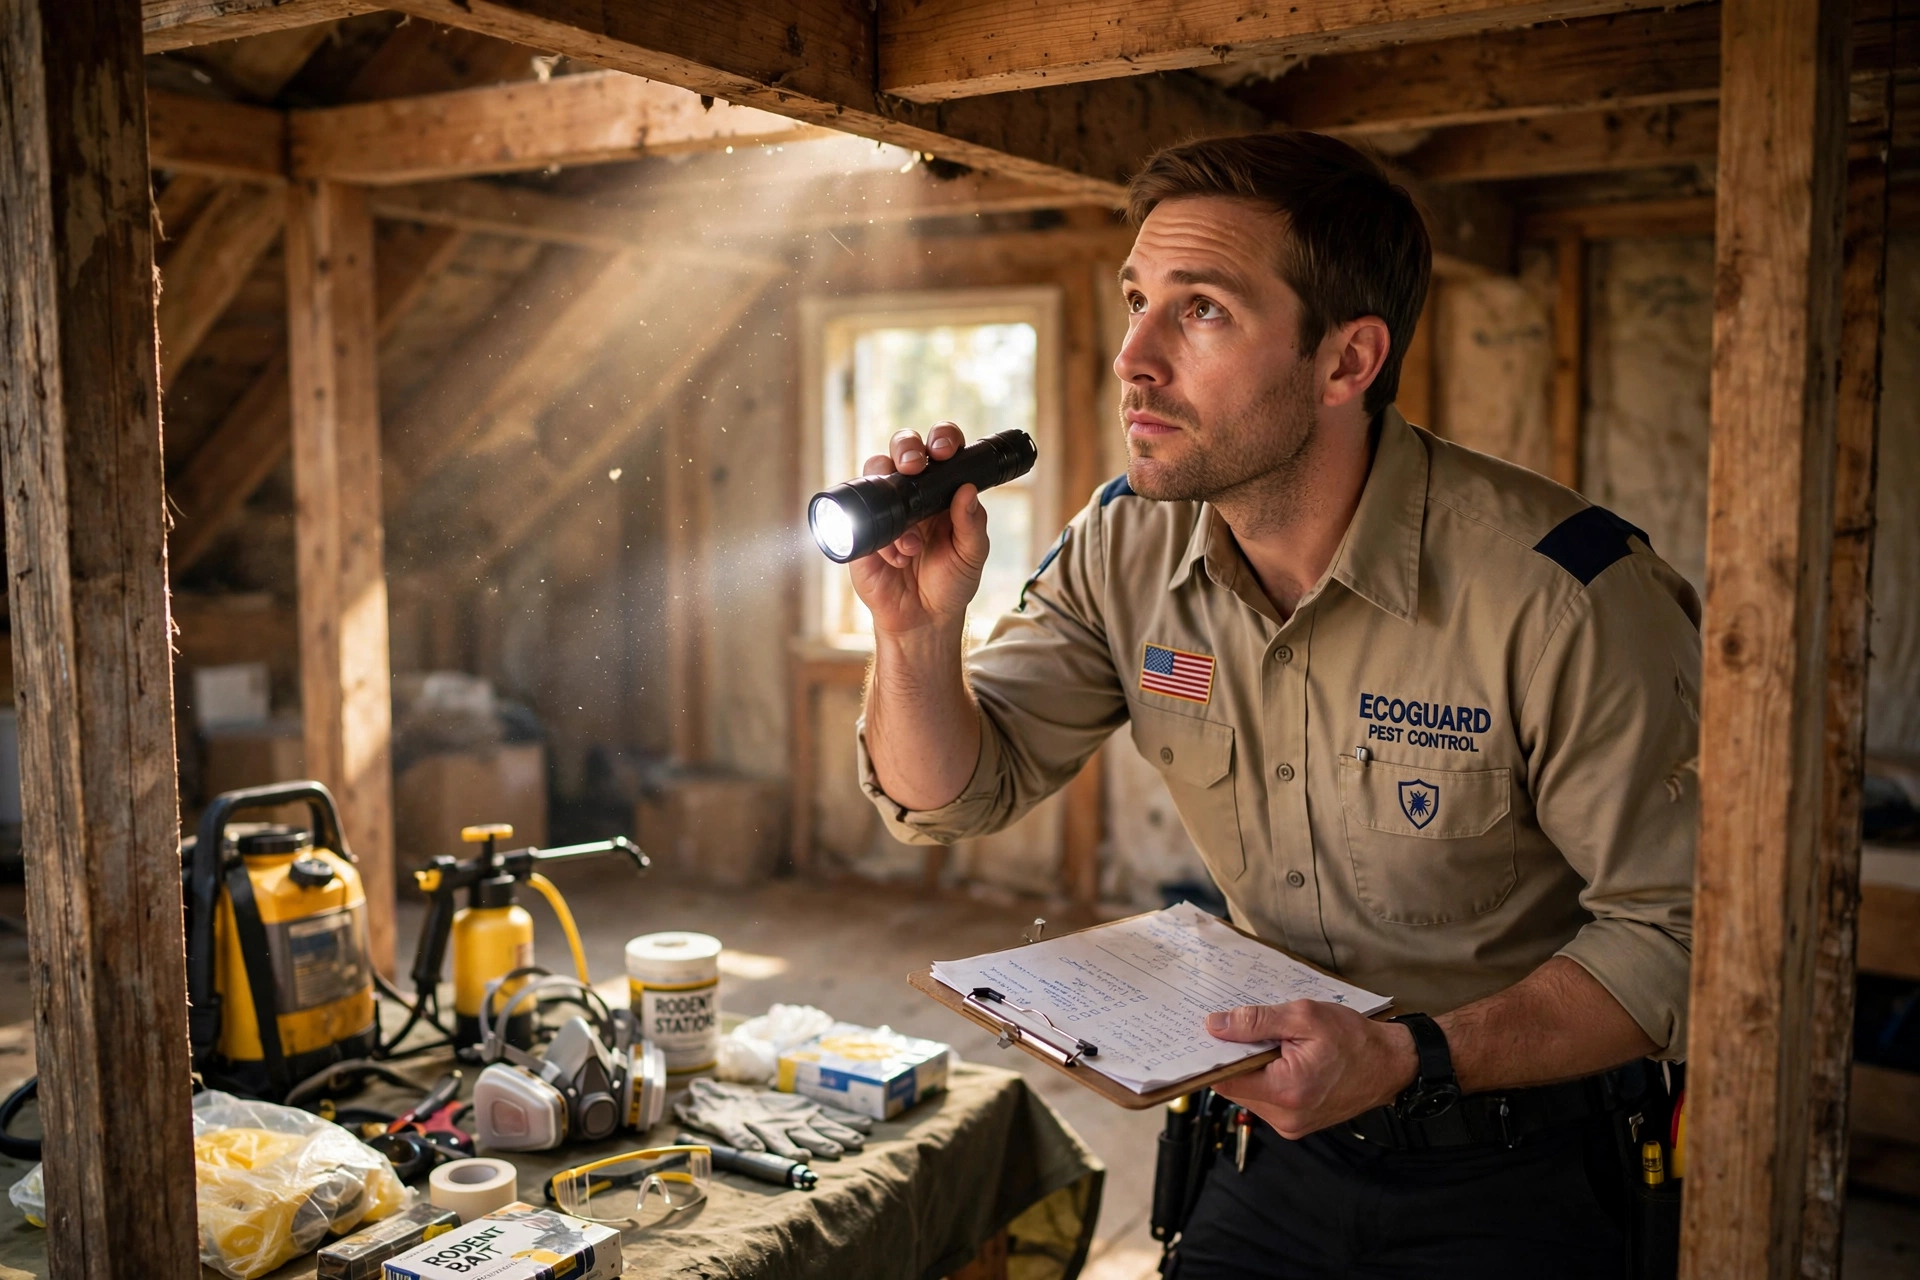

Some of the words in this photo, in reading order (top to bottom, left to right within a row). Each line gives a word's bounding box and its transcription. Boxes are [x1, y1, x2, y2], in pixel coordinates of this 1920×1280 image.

[1360, 693, 1491, 733] ECOGUARD
[1368, 724, 1404, 743] PEST
[1407, 730, 1479, 752] CONTROL
[422, 1226, 505, 1266] RODENT
